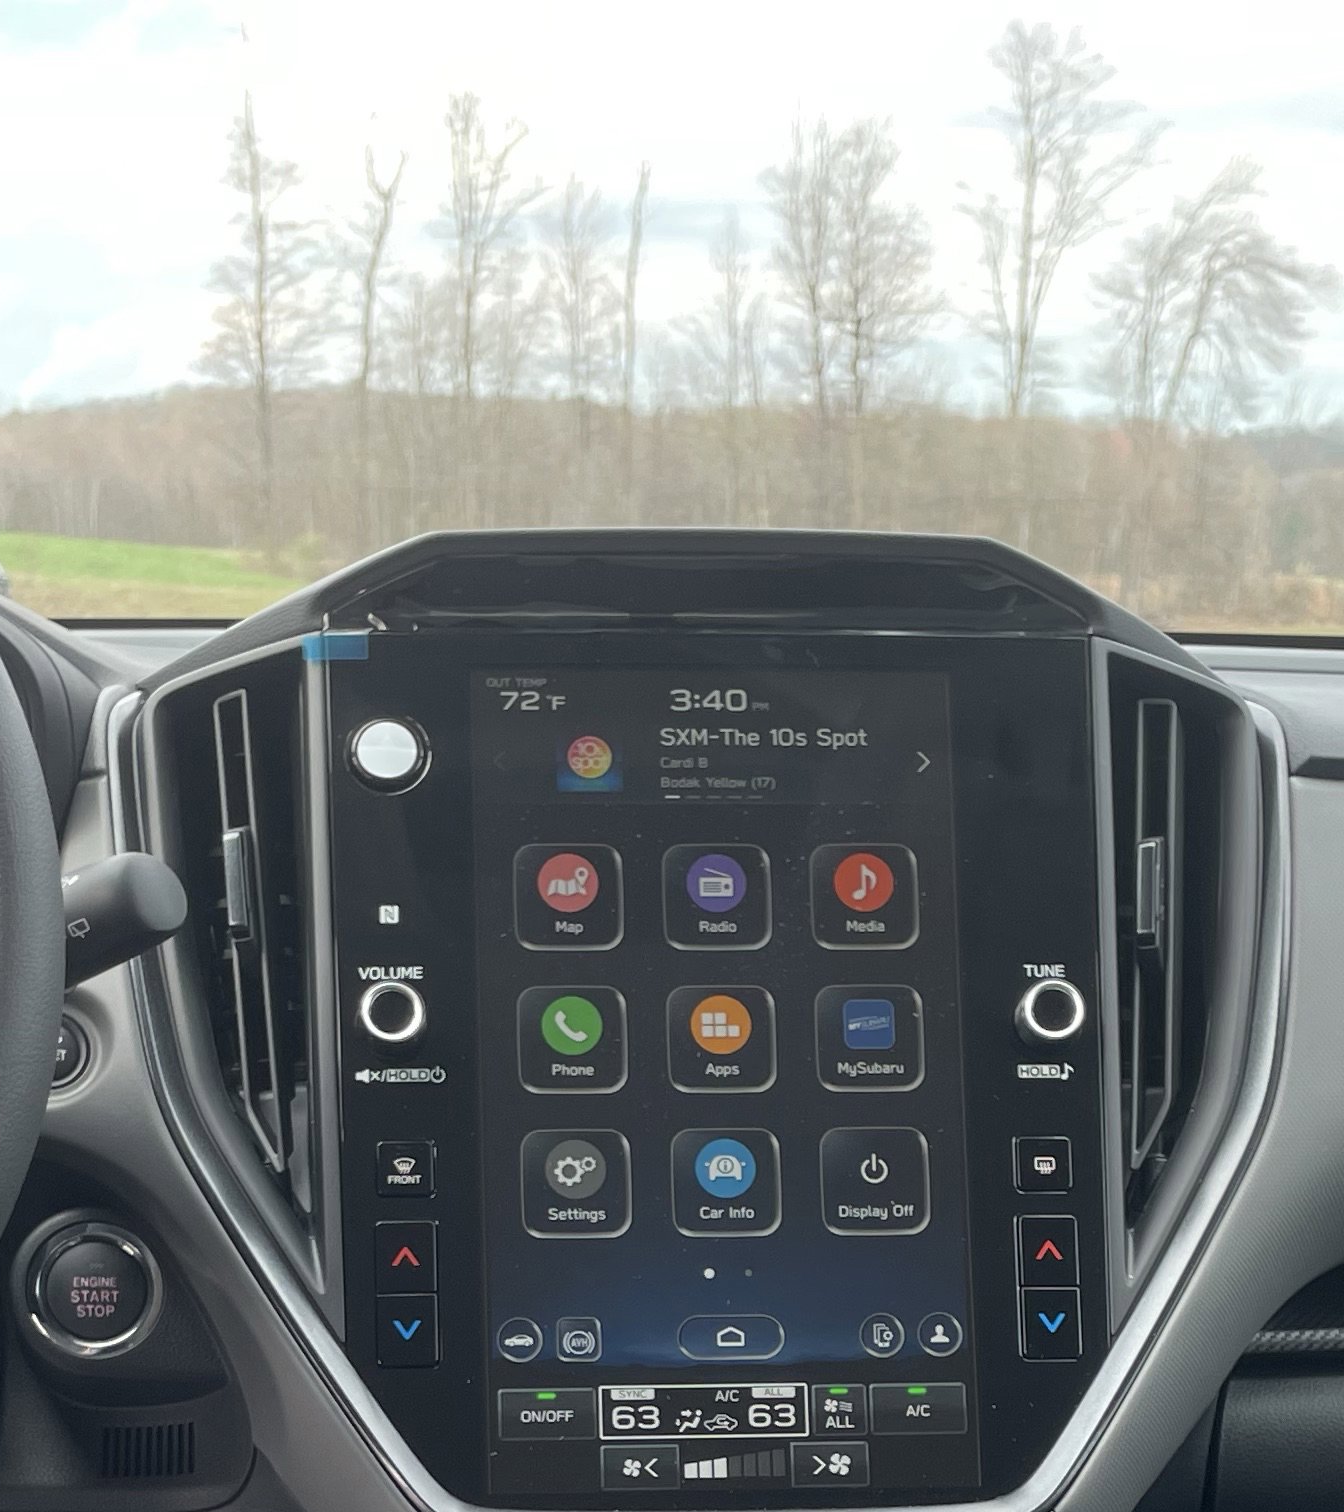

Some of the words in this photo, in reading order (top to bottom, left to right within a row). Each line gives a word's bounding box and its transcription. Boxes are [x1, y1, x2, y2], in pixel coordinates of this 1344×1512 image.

[500, 691, 542, 711] 72
[670, 689, 747, 711] 3:40
[660, 728, 760, 746] SXM-The
[769, 728, 807, 746] 10s
[817, 729, 868, 750] Spot
[660, 757, 694, 768] Cardi
[698, 757, 708, 768] B
[661, 777, 700, 789] Bodak
[705, 777, 746, 788] Yellow
[751, 777, 776, 790] (17)
[555, 921, 583, 935] Map
[699, 921, 737, 932] Radio
[846, 920, 885, 932] Media
[358, 966, 423, 980] VOLUME
[1023, 964, 1065, 977] TUNE
[552, 1064, 594, 1077] Phone
[705, 1063, 739, 1077] Apps
[838, 1062, 904, 1077] MySubaru
[387, 1175, 421, 1184] FRONT
[548, 1208, 606, 1223] Settings
[700, 1207, 724, 1219] Car
[729, 1207, 754, 1218] Info
[839, 1204, 886, 1221] Display
[892, 1204, 913, 1217] Off
[73, 1276, 117, 1288] ENGINE
[71, 1290, 119, 1303] START
[76, 1304, 115, 1318] STOP
[619, 1390, 647, 1398] SYNC
[715, 1389, 739, 1403] A/C
[764, 1388, 784, 1397] ALL
[521, 1410, 573, 1422] ON/OFF
[748, 1404, 796, 1428] 63
[906, 1405, 930, 1416] A/C
[612, 1406, 660, 1429] 63
[826, 1416, 855, 1428] ALL
